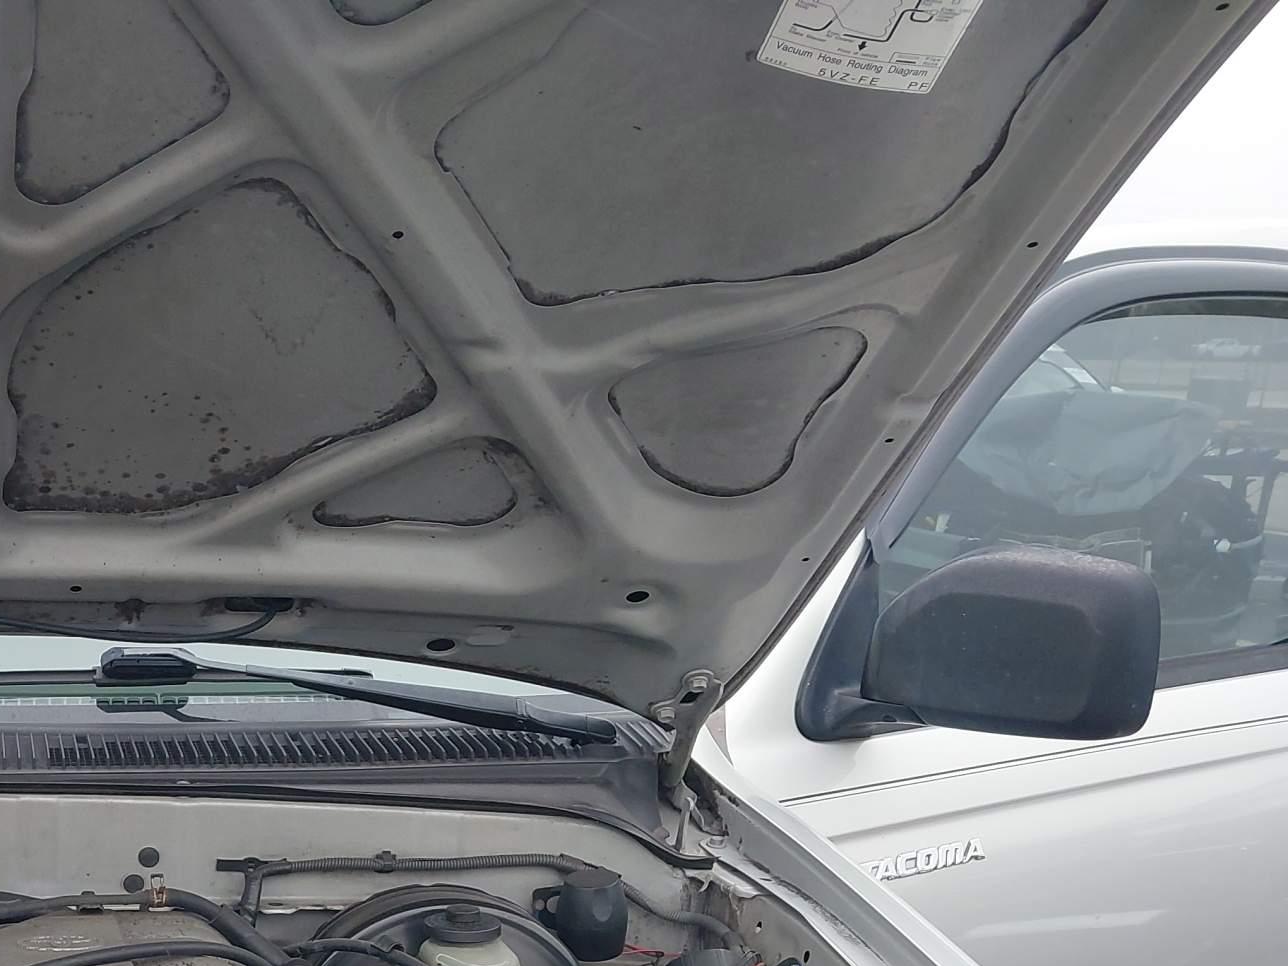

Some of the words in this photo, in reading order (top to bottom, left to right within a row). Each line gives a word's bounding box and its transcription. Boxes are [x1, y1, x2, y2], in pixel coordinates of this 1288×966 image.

[776, 41, 813, 58] Vacuum
[817, 52, 843, 65] Hose
[846, 59, 884, 74] Routing
[888, 65, 928, 77] Diagram
[907, 81, 930, 91] PF
[860, 838, 986, 881] TACOMA
